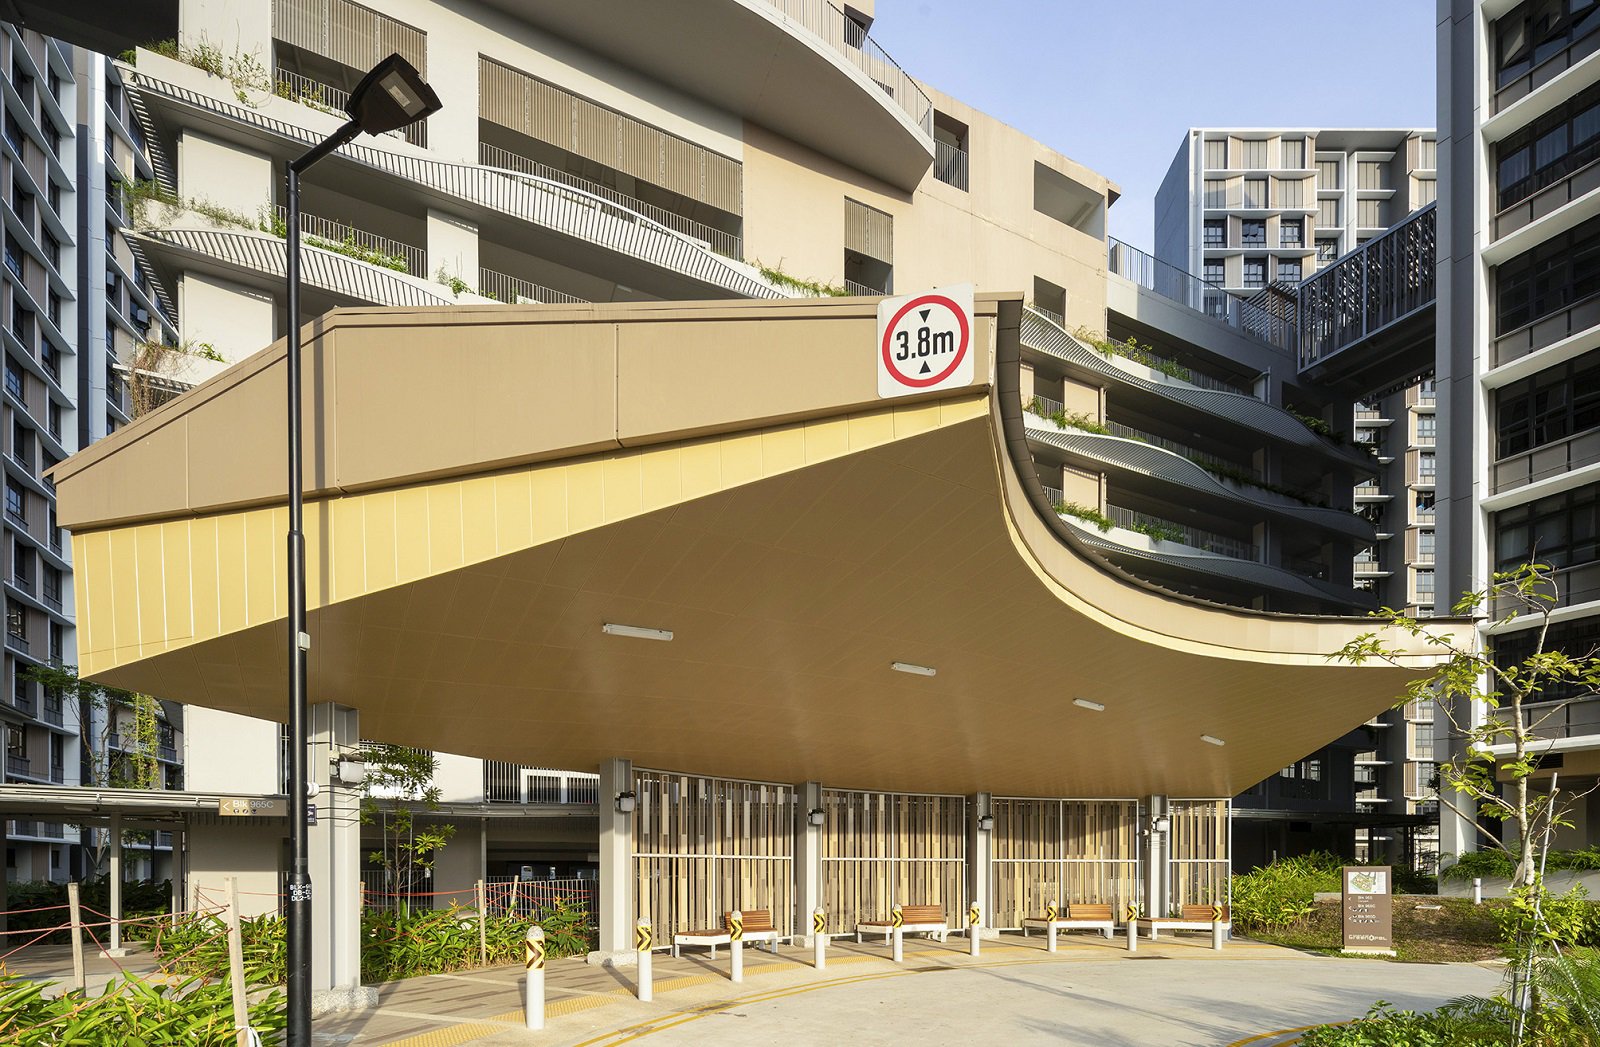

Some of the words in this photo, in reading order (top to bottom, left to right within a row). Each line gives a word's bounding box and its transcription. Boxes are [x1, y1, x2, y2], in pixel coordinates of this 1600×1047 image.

[896, 326, 954, 361] 3.8m
[232, 800, 248, 808] Blk
[250, 800, 274, 809] 965C
